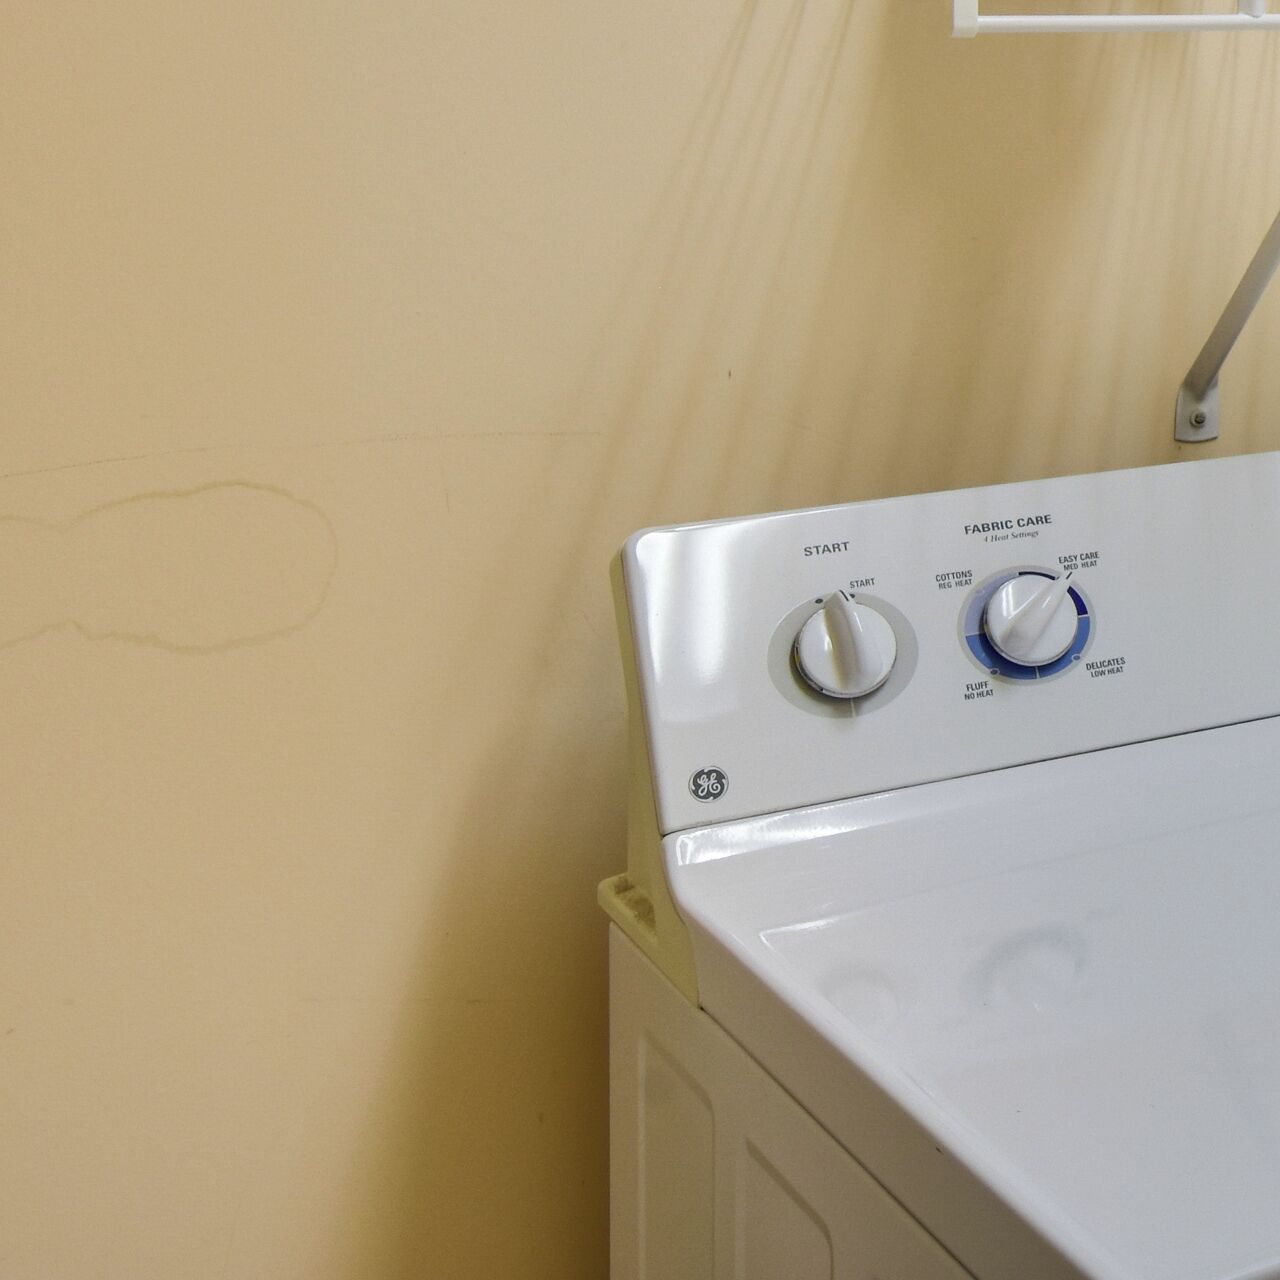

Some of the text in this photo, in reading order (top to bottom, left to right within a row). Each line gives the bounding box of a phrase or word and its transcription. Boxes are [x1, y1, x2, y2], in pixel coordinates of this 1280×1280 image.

[964, 514, 1052, 535] FABRIC CARE
[991, 533, 1009, 542] Heat
[1011, 530, 1039, 539] Settings
[803, 541, 850, 557] START
[1058, 551, 1100, 564] EASY CARE
[1063, 560, 1097, 571] MED HEAT
[936, 569, 973, 582] COTTONS
[849, 577, 875, 589] START
[938, 578, 972, 590] REG HEAT
[1086, 656, 1126, 670] DELICATES
[1090, 666, 1123, 678] LOW HEAT
[966, 681, 988, 691] FLUFF
[964, 689, 993, 700] NO HEAT
